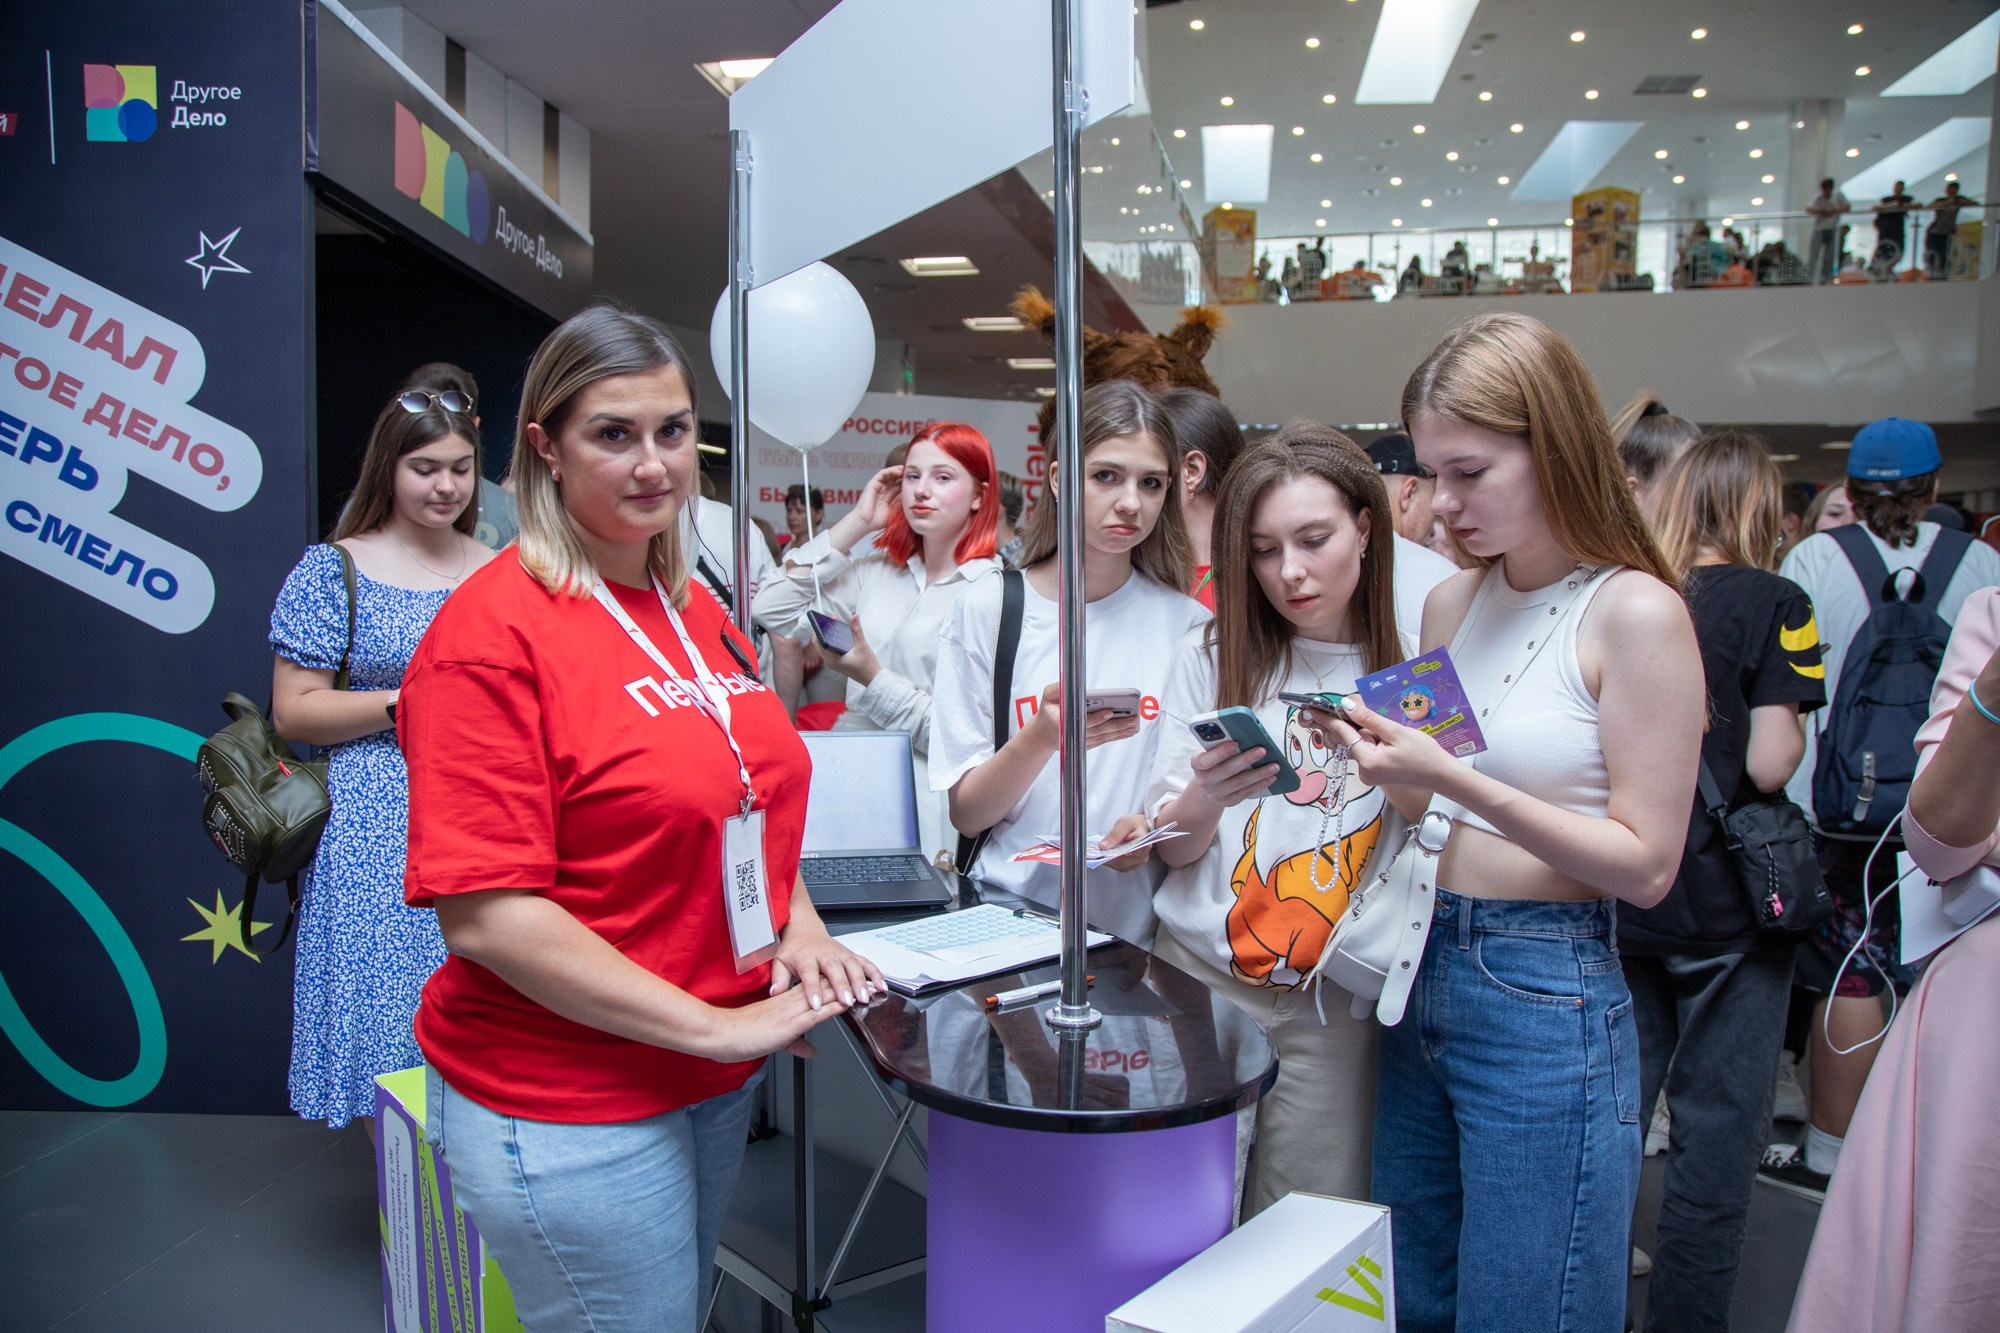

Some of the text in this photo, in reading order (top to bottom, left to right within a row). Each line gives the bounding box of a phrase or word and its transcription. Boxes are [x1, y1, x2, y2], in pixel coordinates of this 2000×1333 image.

[170, 80, 242, 104] Другое
[171, 106, 227, 129] Дело
[495, 205, 563, 279] Другое Дело
[0, 263, 178, 385] ЕЛАЛ
[82, 391, 231, 492] ДЕЛО,
[5, 499, 179, 601] СМЕЛО
[418, 1138, 425, 1152] С
[436, 1218, 454, 1287] МЕНЯЙ
[455, 1209, 470, 1281] МЕНЯЙ
